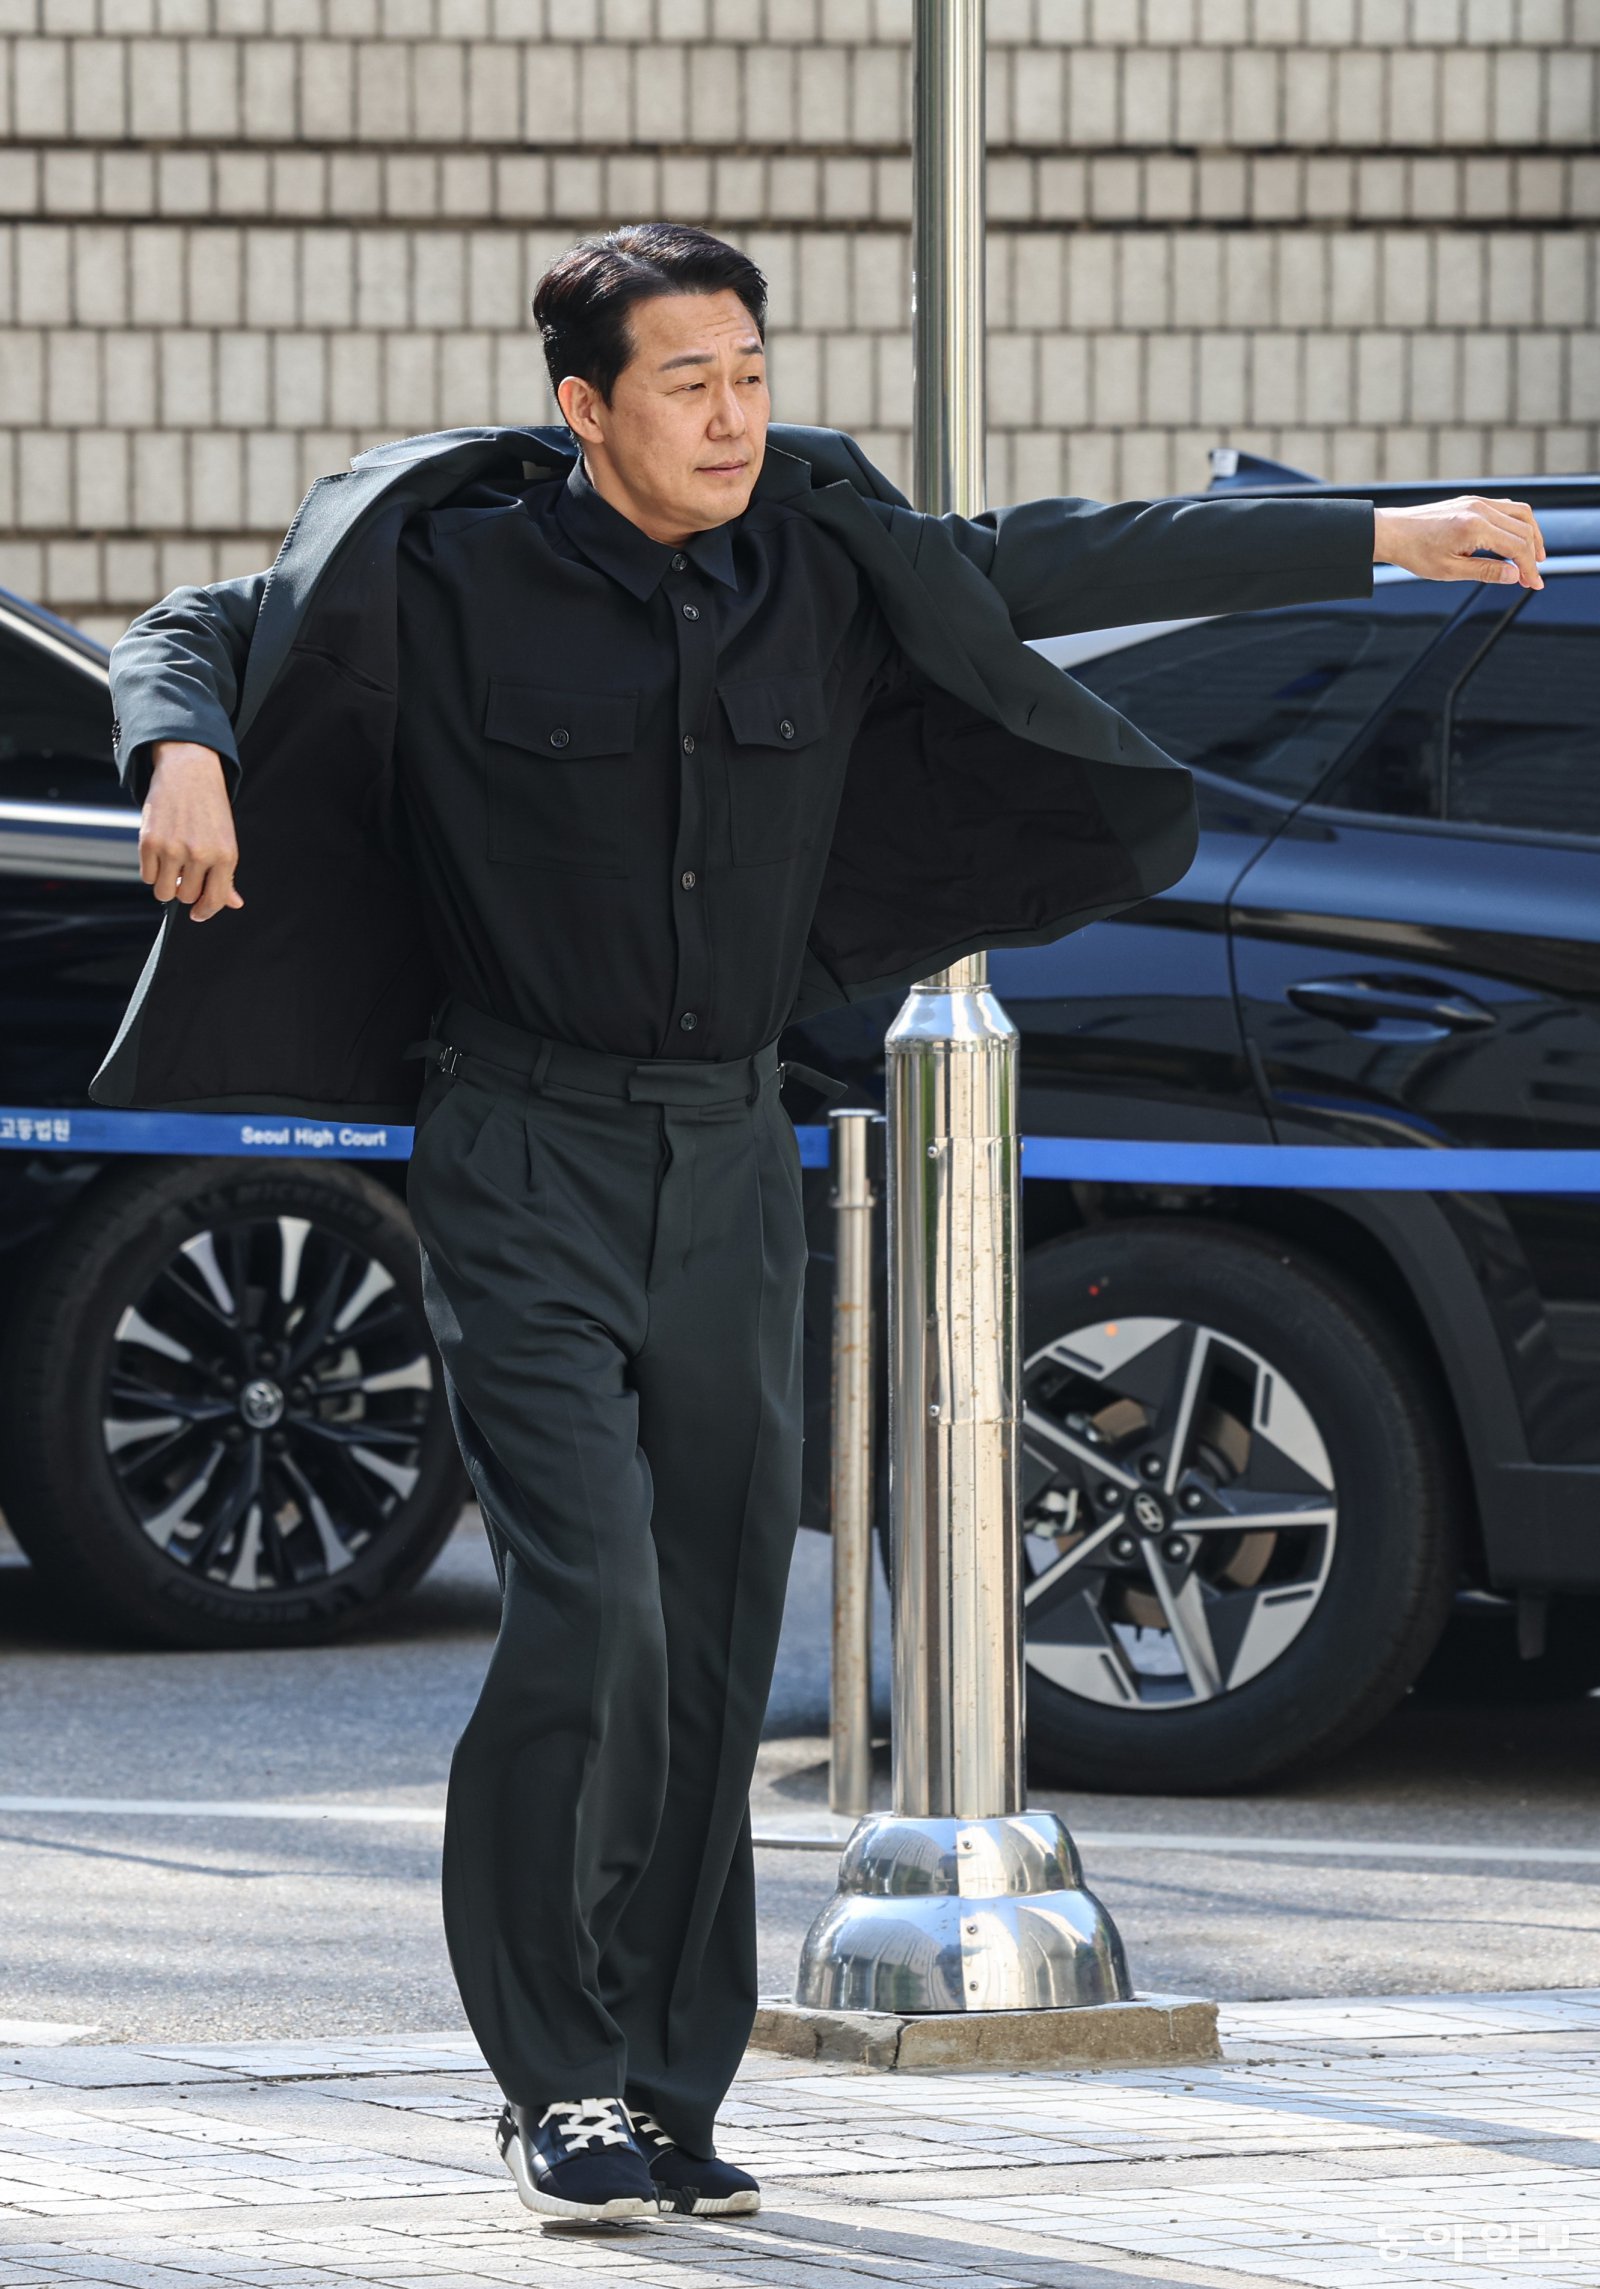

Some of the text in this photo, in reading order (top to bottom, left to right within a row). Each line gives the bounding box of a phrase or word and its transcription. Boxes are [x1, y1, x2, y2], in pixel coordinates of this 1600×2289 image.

[0, 1117, 70, 1142] 고등법원
[241, 1126, 387, 1148] Seoul High Court
